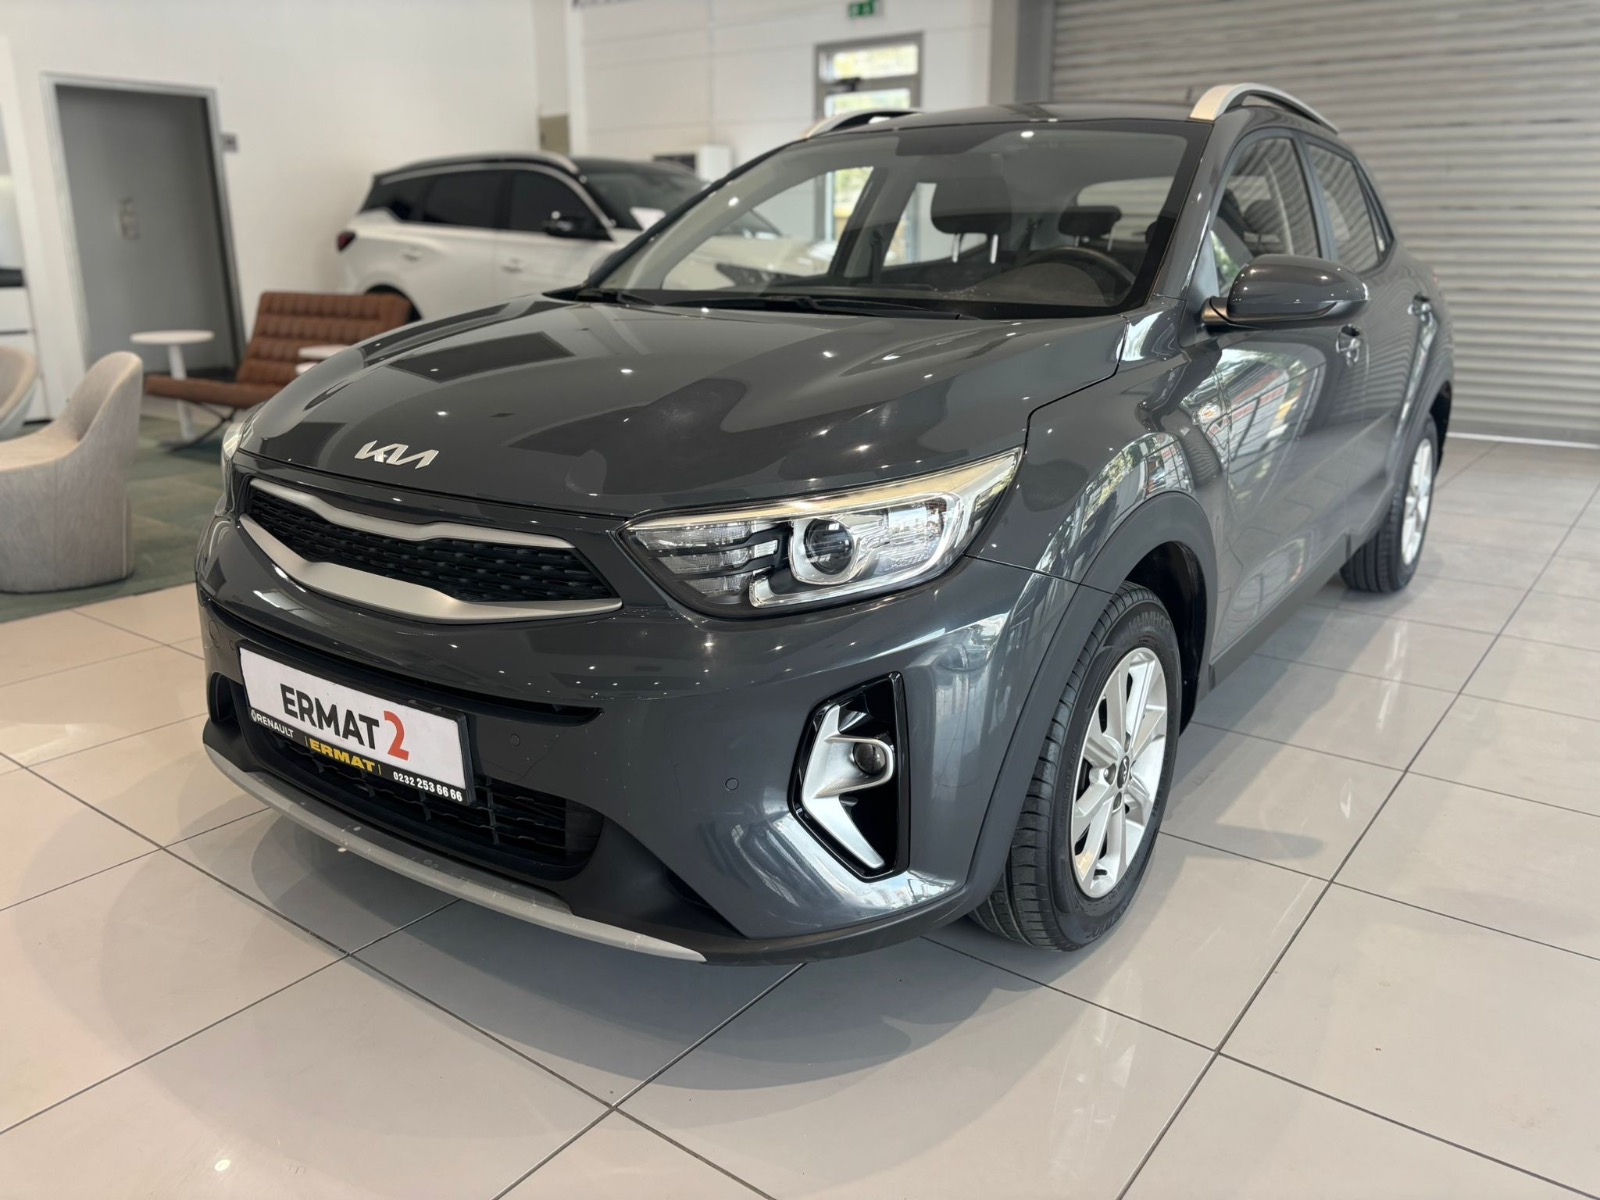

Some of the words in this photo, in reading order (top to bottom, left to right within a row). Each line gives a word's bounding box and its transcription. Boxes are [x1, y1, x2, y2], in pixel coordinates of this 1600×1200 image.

[354, 440, 440, 470] KIA
[256, 712, 294, 738] RENAULT
[279, 683, 380, 750] ERMAT
[309, 738, 376, 773] ERMAT
[393, 771, 416, 787] 0232
[416, 777, 436, 793] 253
